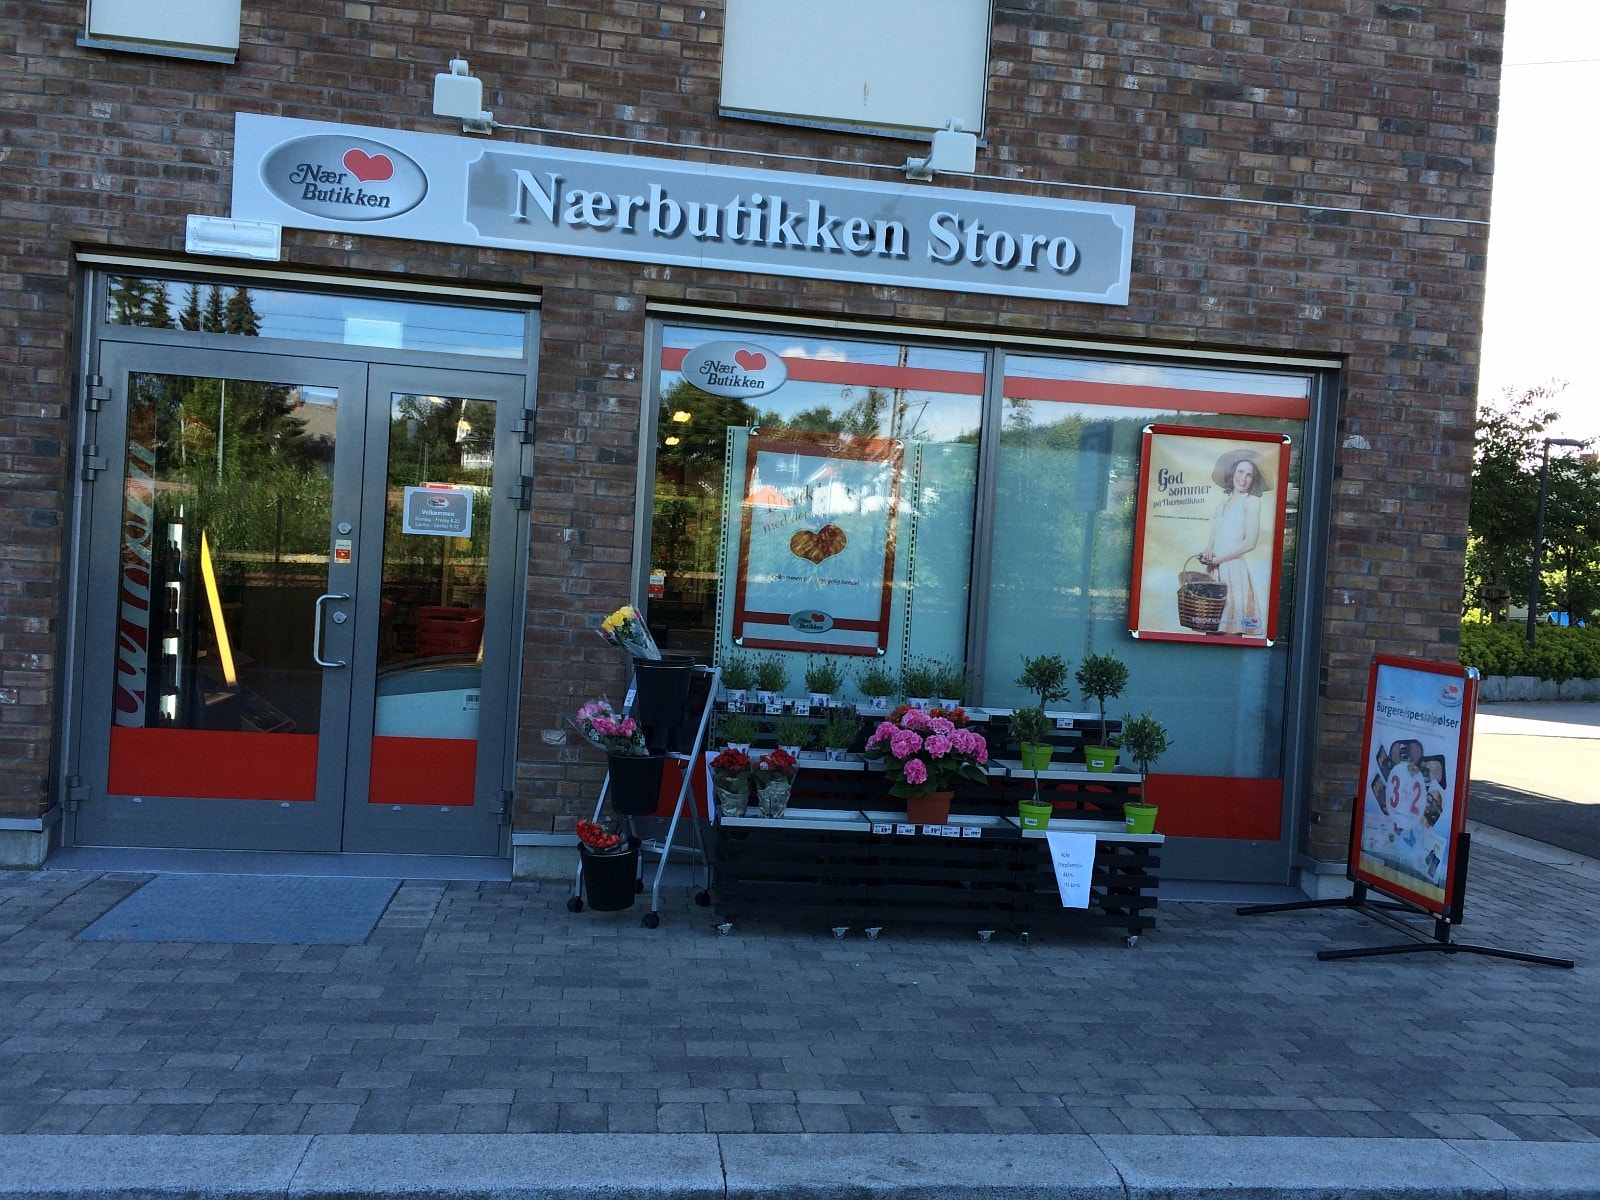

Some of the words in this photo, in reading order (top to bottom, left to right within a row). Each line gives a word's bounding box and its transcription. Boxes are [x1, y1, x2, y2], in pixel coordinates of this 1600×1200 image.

[289, 163, 347, 184] Nær
[301, 183, 391, 208] Butikken
[509, 169, 907, 256] Nærbutikken
[926, 211, 1077, 271] Storo
[700, 360, 737, 374] Nær
[707, 373, 765, 389] Butikken
[1157, 468, 1185, 492] God
[1168, 485, 1212, 497] sommer
[1376, 701, 1460, 729] Burgere/spesialpølser
[1389, 774, 1401, 809] 3
[1409, 781, 1422, 816] 2
